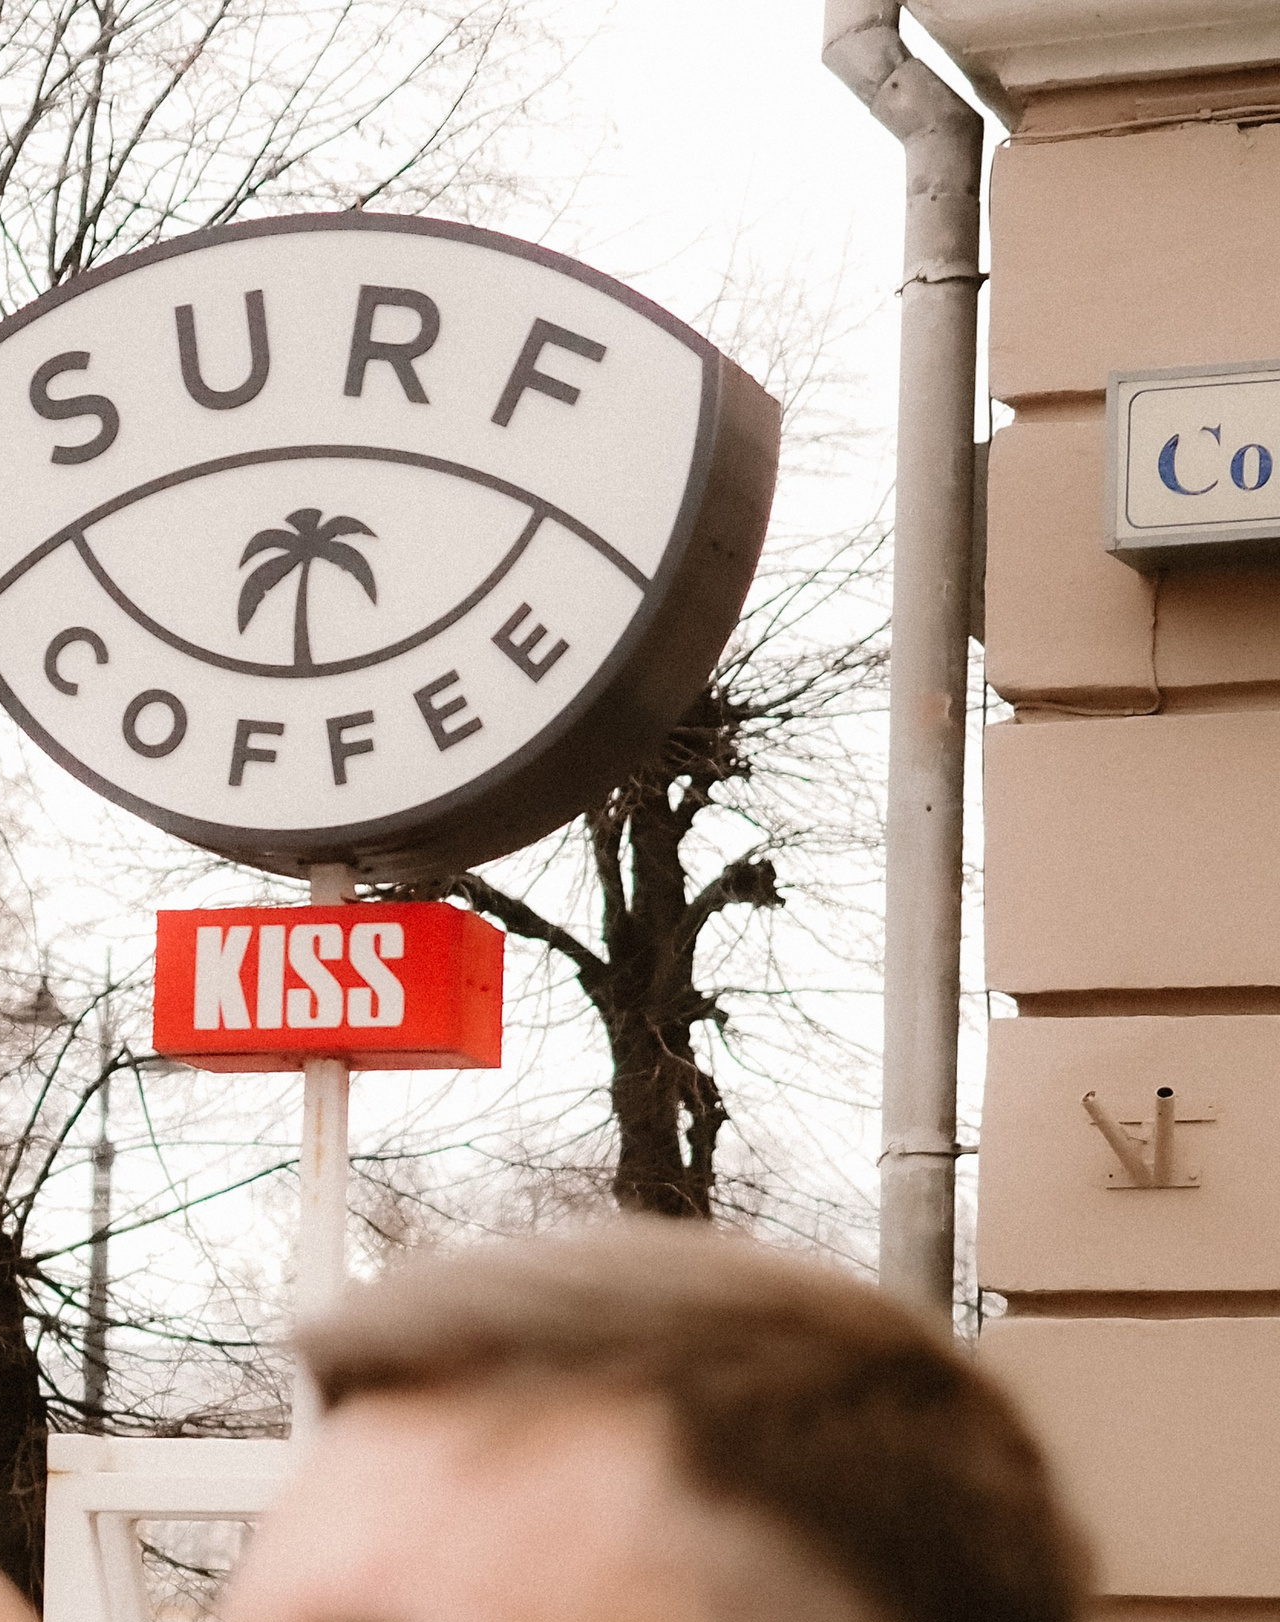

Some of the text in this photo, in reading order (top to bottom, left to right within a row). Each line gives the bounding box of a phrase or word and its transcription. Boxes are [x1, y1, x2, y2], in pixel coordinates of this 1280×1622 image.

[29, 285, 608, 466] SURF
[44, 602, 571, 787] COFFEE
[194, 922, 405, 1030] KISS
